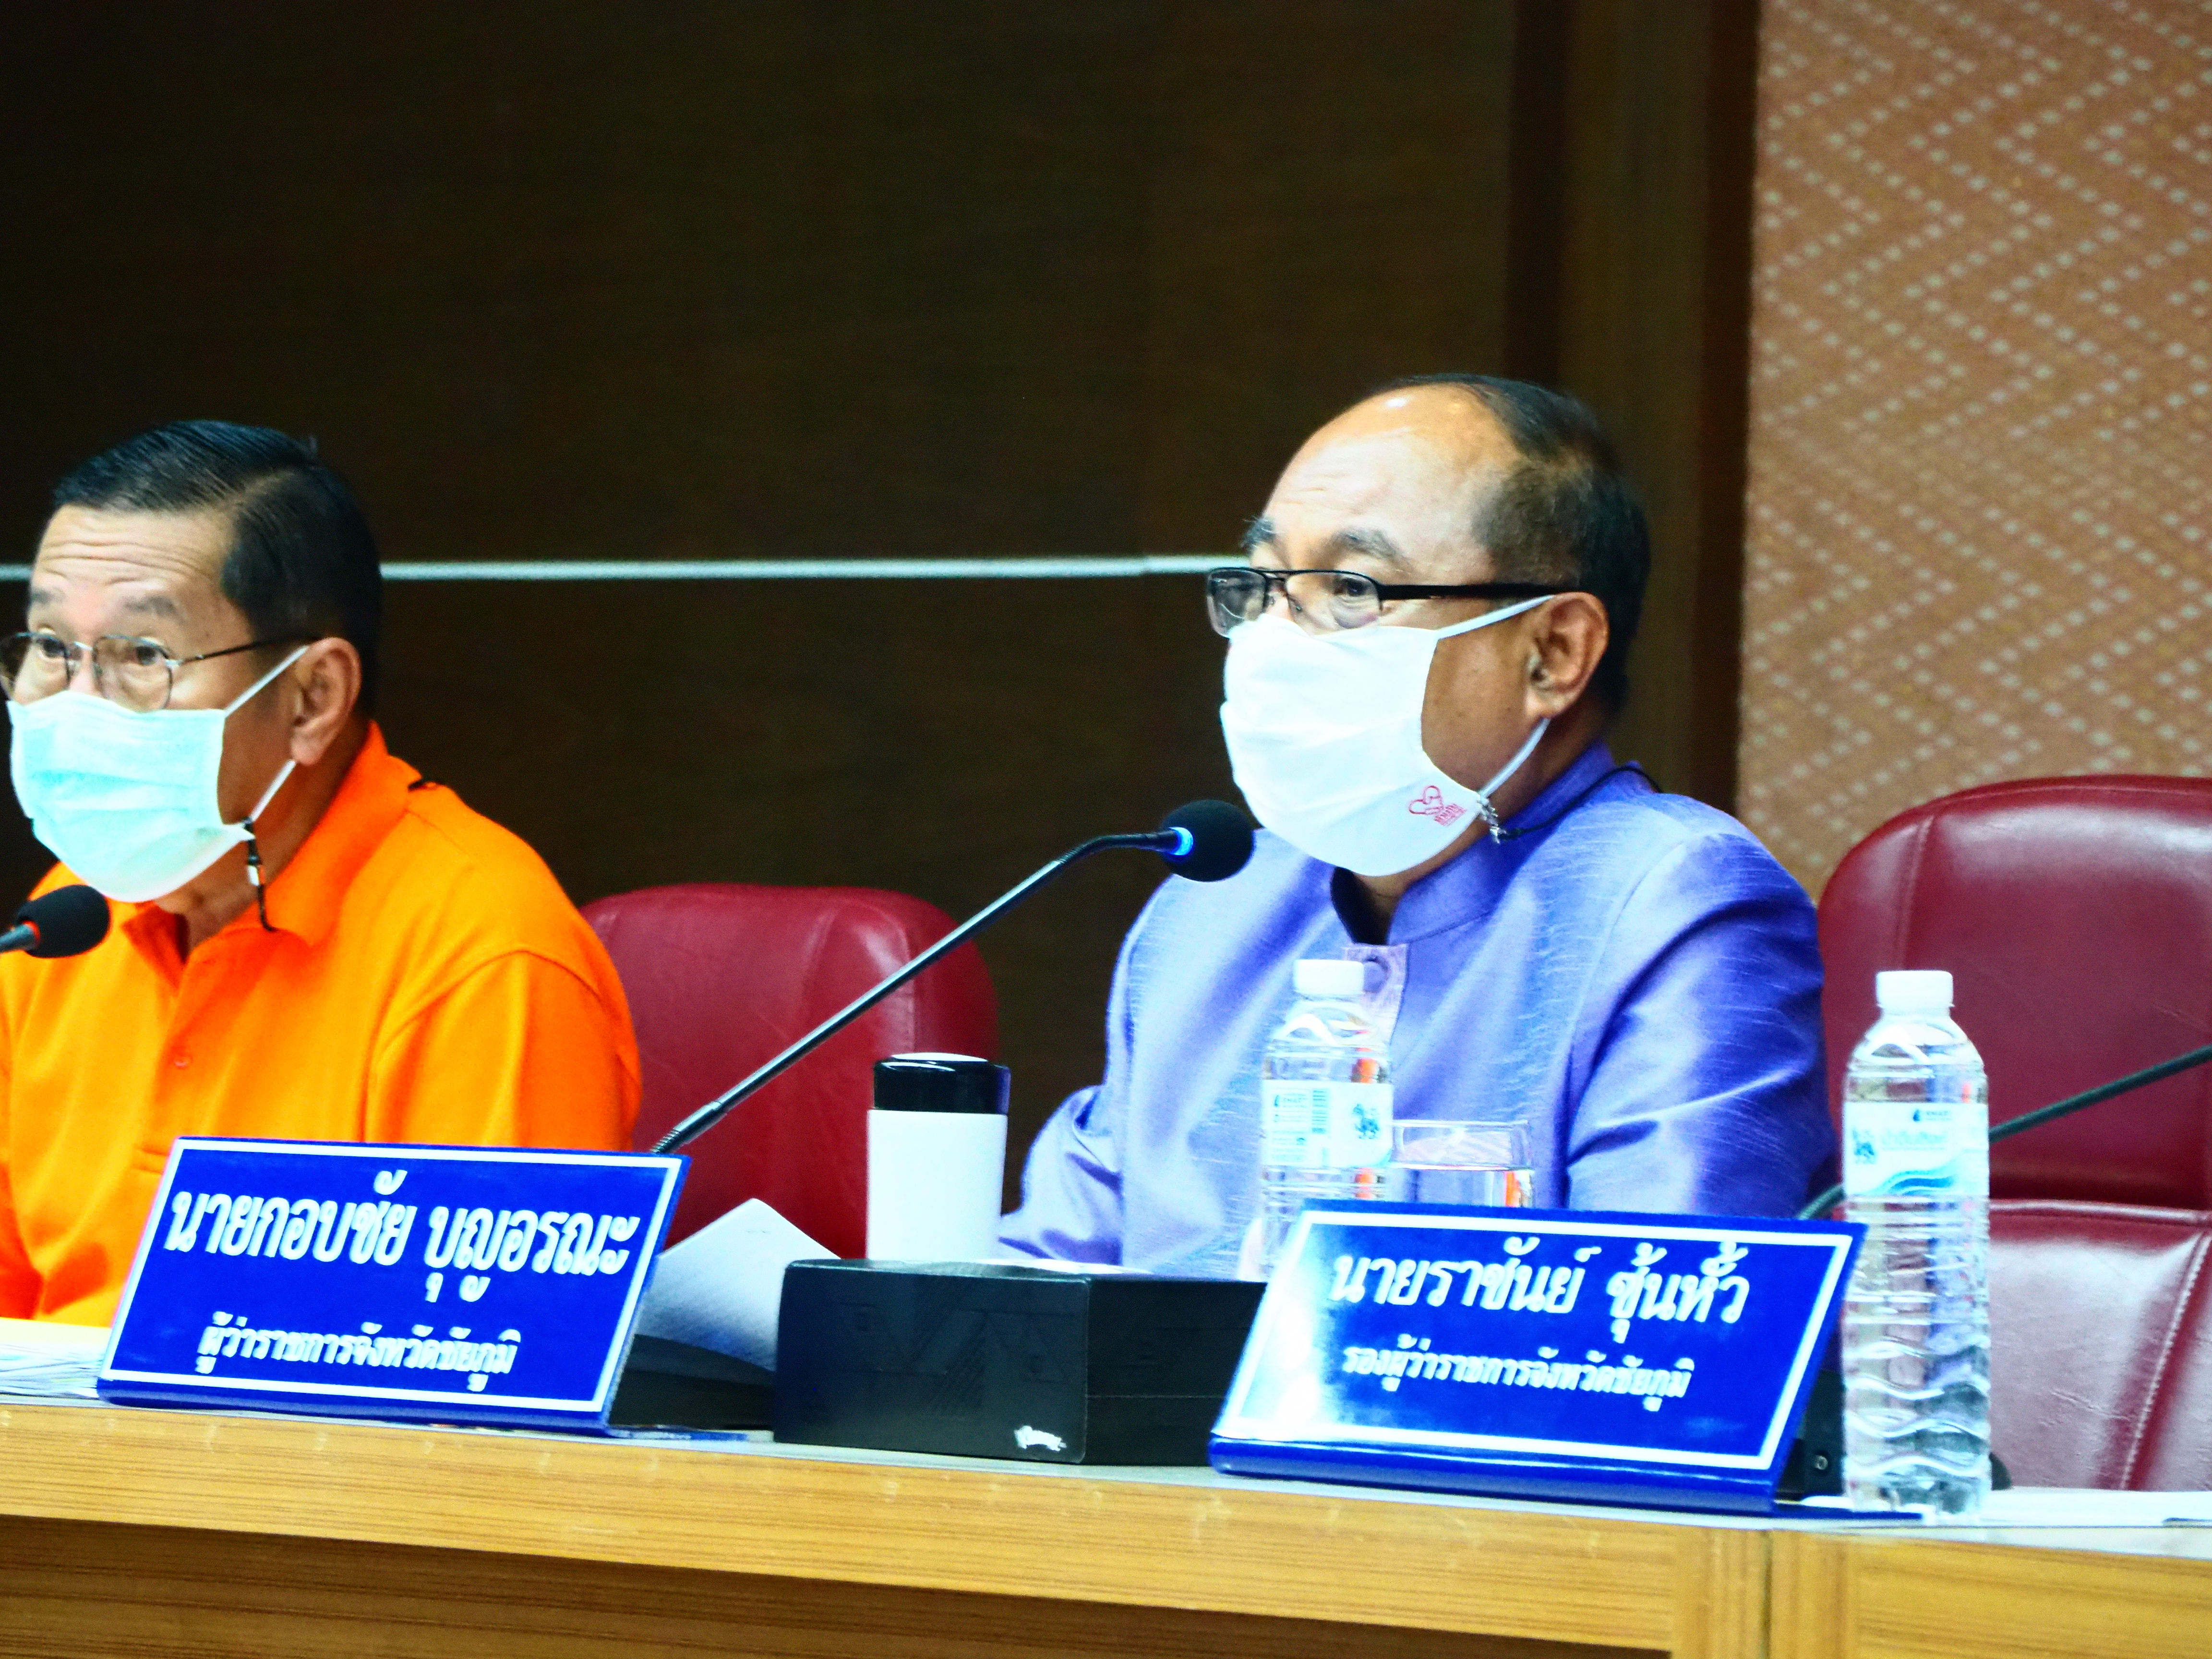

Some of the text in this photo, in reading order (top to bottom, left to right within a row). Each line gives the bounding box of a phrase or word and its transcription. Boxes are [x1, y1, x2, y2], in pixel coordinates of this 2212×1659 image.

[165, 1170, 640, 1302] นายกอบชัย บุญอรณะ
[1329, 1237, 1602, 1313] นายราชันย์
[196, 1311, 521, 1392] ผู้ว่าราชการจังหวัดชัยภูมิ
[1343, 1334, 1695, 1412] รองผู้ว่าราชการจังหวัดชัยภูมิ
